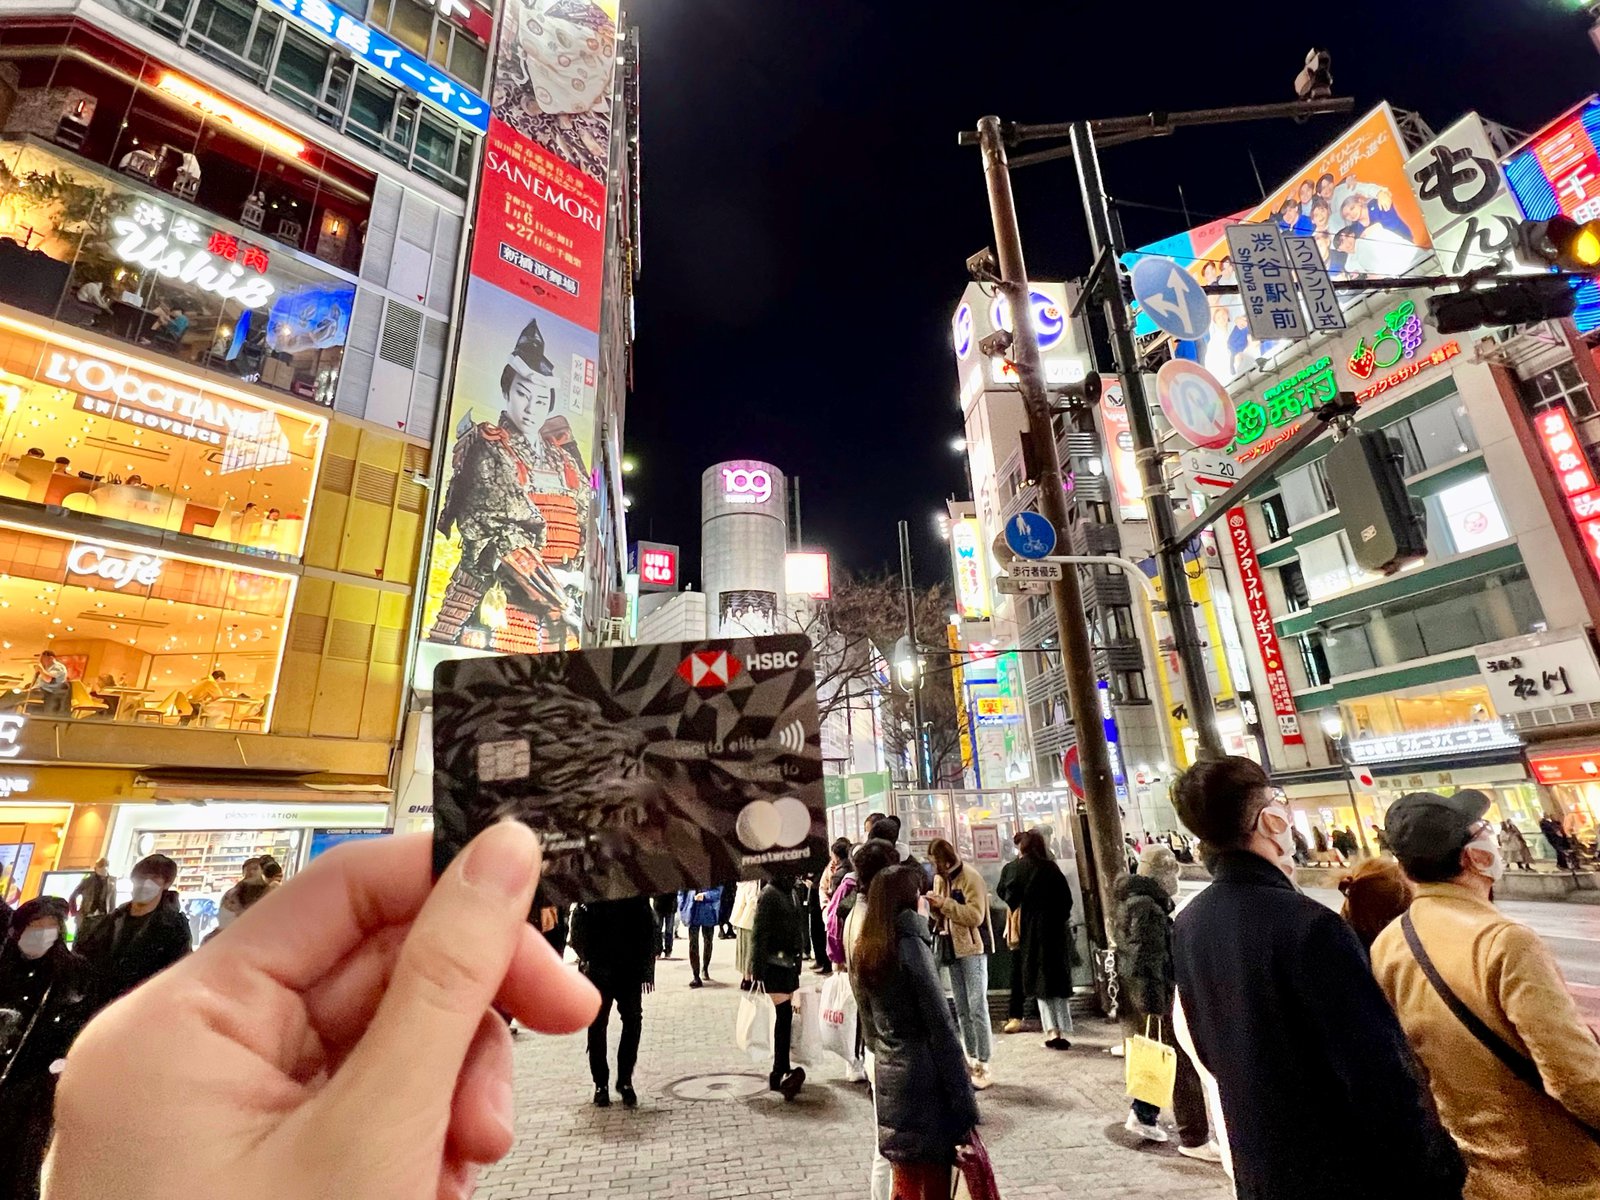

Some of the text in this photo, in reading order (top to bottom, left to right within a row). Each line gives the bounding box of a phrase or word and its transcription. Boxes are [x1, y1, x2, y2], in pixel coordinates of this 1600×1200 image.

[486, 150, 601, 232] SANEMORI
[133, 201, 270, 276] 渋谷 焼肉
[502, 246, 577, 294] 新橋演舞場
[1237, 247, 1264, 318] Shibuya Sta.
[1250, 232, 1297, 330] 渋谷駅前
[1294, 239, 1338, 327] スクランブル式
[82, 395, 222, 446] EN PROVENCE
[1267, 369, 1336, 428] 西村
[722, 468, 772, 504] 109
[67, 546, 165, 590] Café
[1013, 566, 1059, 578] 歩行者優先
[1233, 527, 1277, 659] ウィンターフルーツギフト
[746, 651, 799, 671] HSBC
[260, 812, 299, 820] STATION
[741, 846, 811, 866] mastercard
[823, 1008, 845, 1025] WEGO
